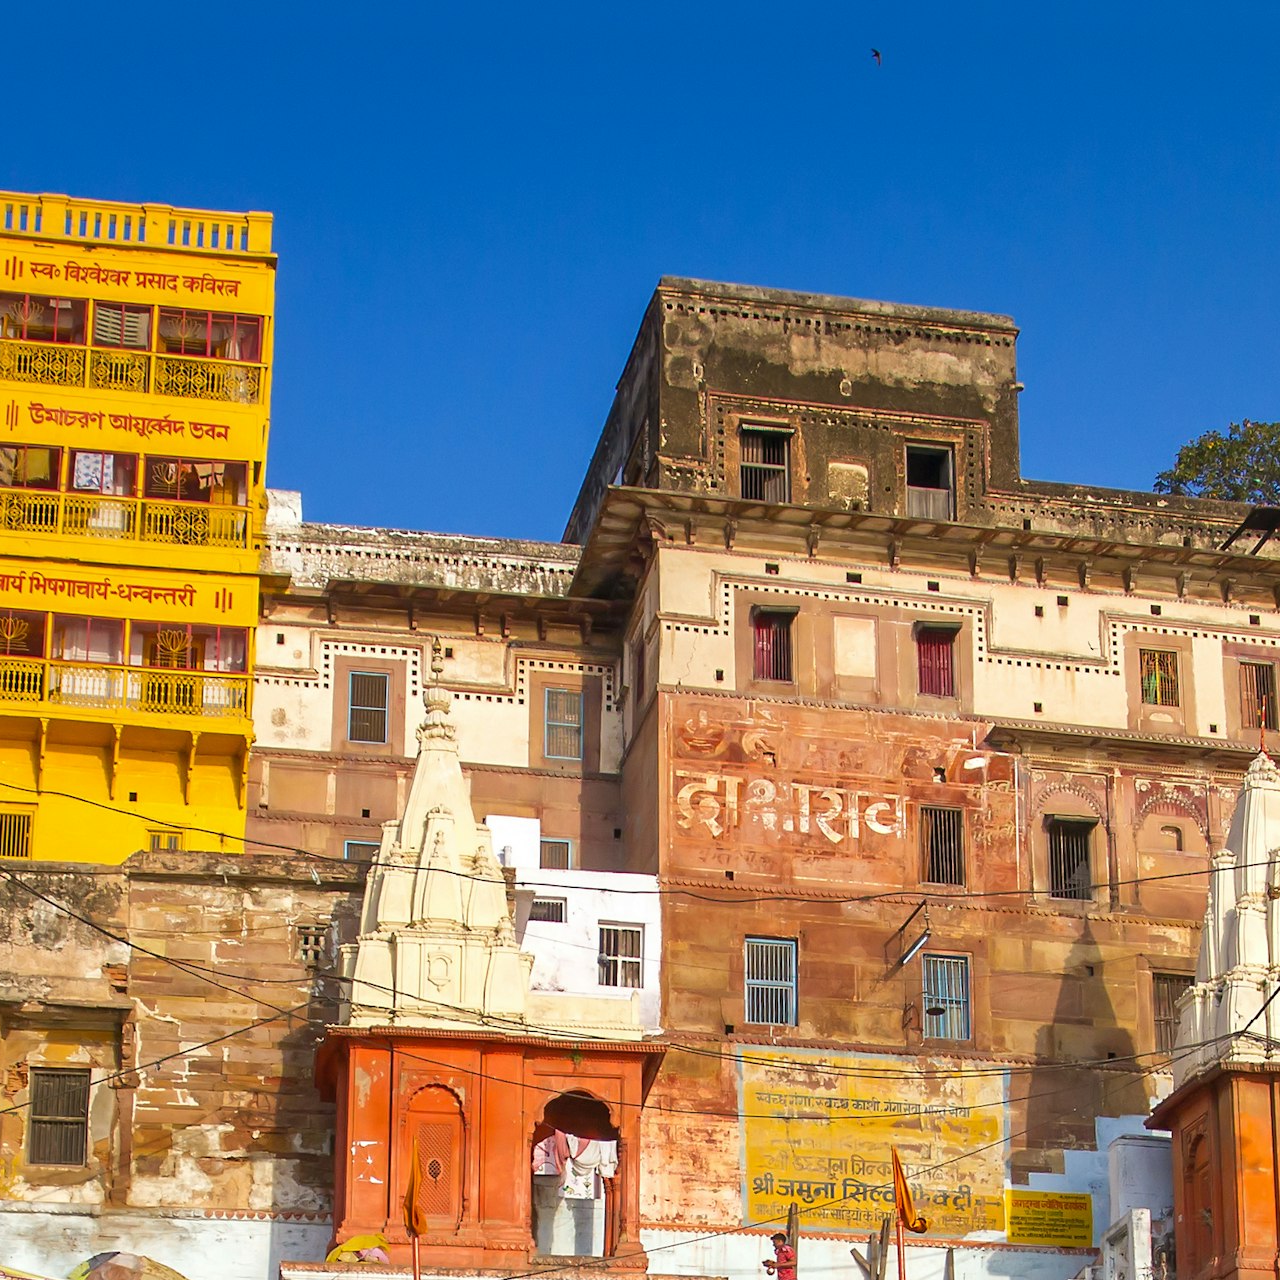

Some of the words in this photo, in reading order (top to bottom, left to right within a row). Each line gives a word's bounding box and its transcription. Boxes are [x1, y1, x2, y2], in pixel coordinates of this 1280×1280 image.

[64, 261, 131, 286] विश्वेश्वर
[135, 271, 179, 294] प्रसाद
[182, 273, 241, 297] कविरत्न
[28, 401, 106, 430] উমাচরণ
[189, 421, 230, 441] ভবন
[753, 1172, 774, 1195] श्री
[777, 1180, 836, 1203] जमुना
